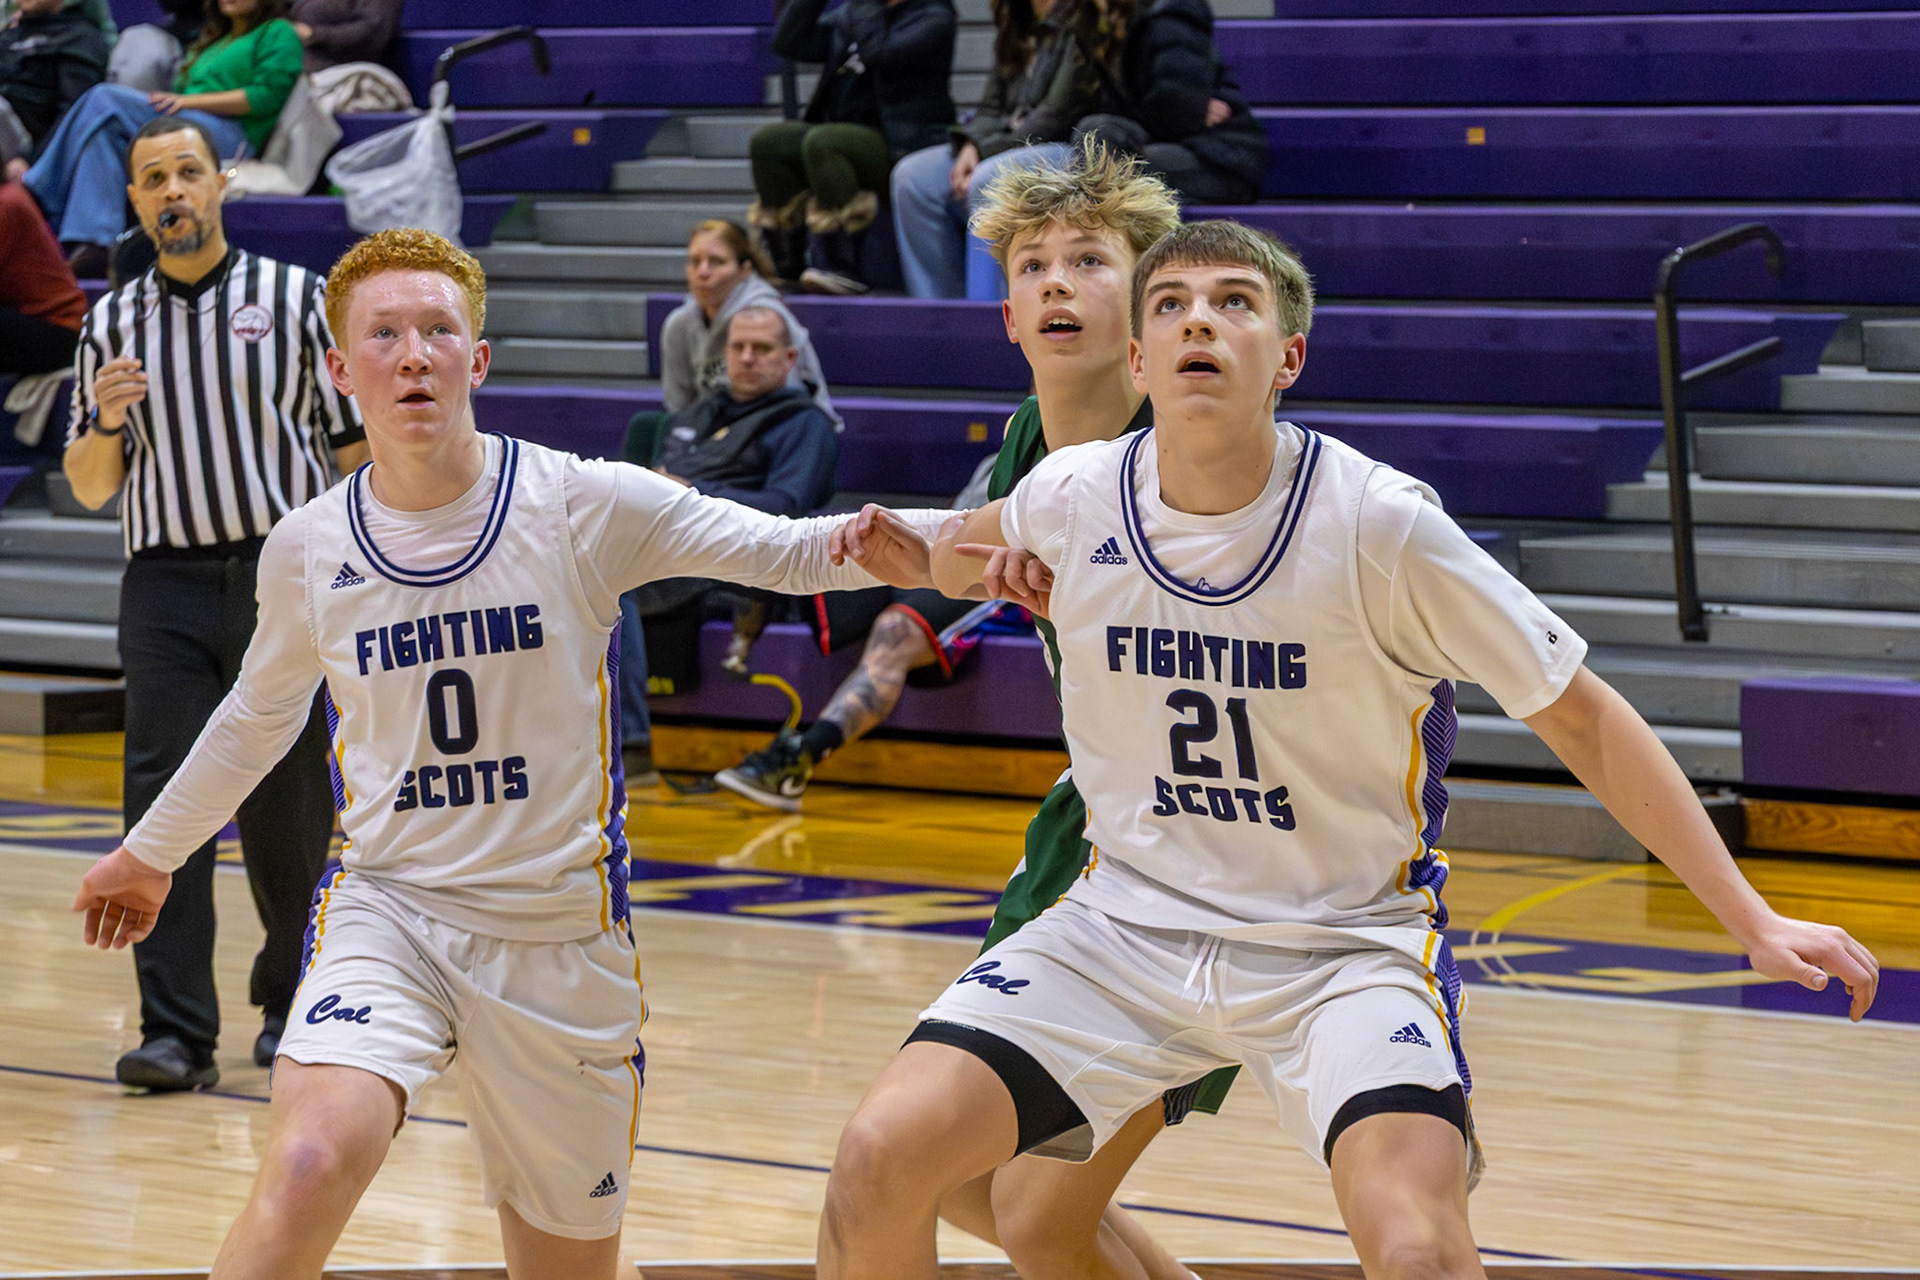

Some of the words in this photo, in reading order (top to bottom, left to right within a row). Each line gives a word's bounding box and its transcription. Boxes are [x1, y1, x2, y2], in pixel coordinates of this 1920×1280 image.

[331, 576, 366, 590] adidas
[1090, 554, 1128, 565] adidas
[355, 604, 544, 676] FIGHTING
[1106, 625, 1307, 690] FIGHTING
[426, 668, 479, 755] 0
[1165, 688, 1259, 782] 21
[394, 755, 530, 813] SCOTS
[1152, 775, 1297, 832] SCOTS
[956, 960, 1031, 995] Cal
[306, 994, 372, 1025] Cal
[1389, 1034, 1432, 1049] adidas
